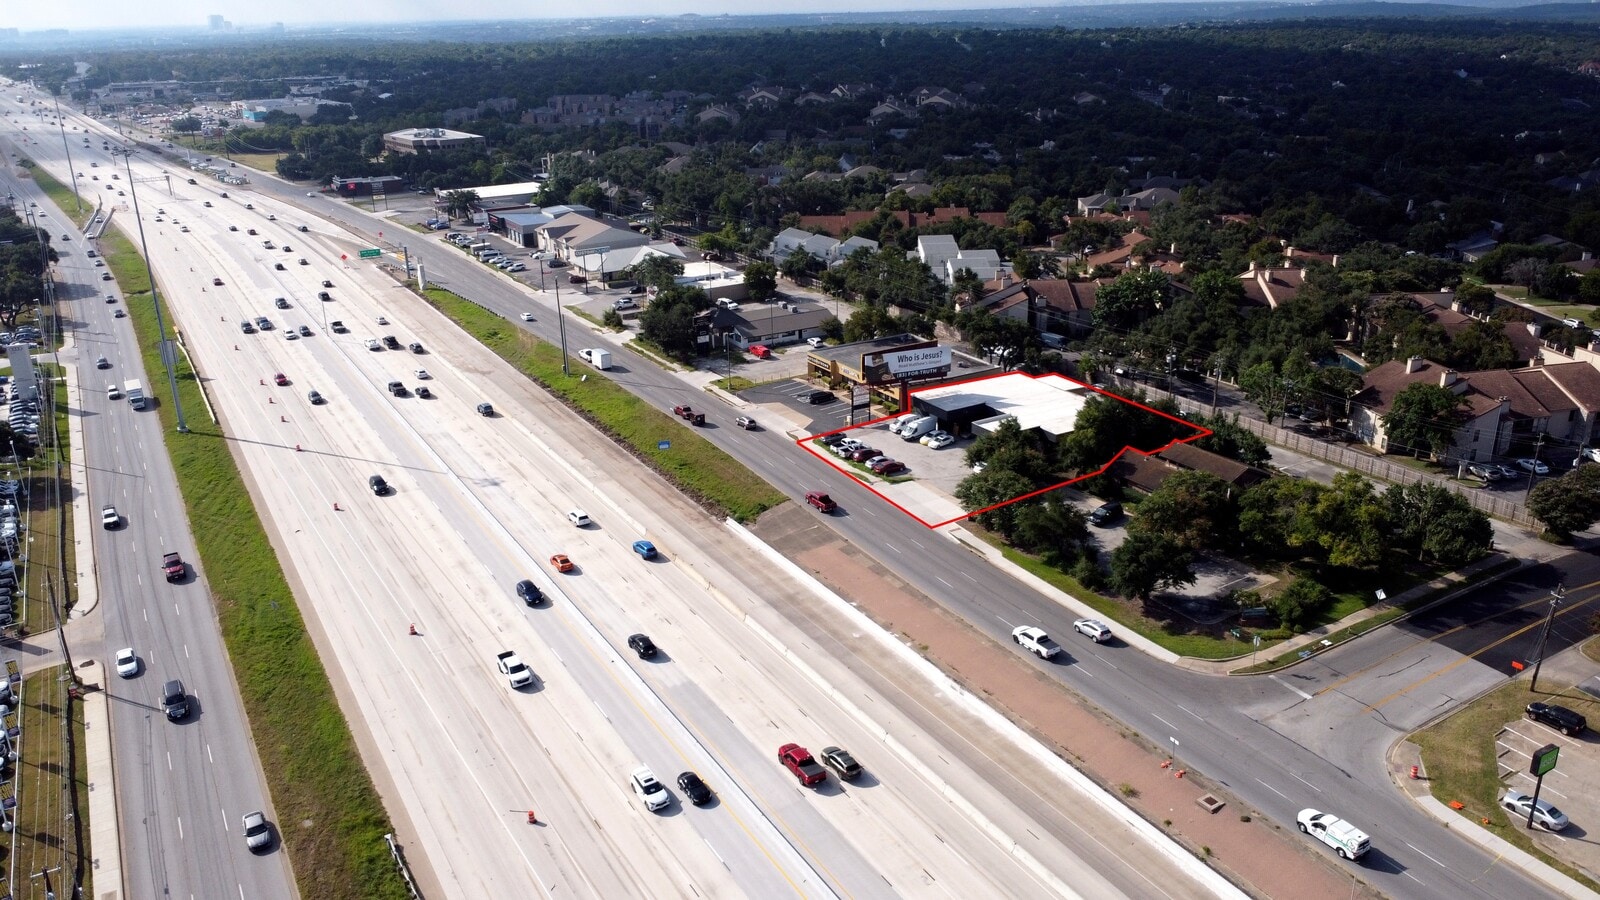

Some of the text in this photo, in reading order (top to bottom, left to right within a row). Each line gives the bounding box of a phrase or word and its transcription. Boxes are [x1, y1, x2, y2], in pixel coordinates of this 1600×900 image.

[897, 350, 943, 363] Who is Jesus?
